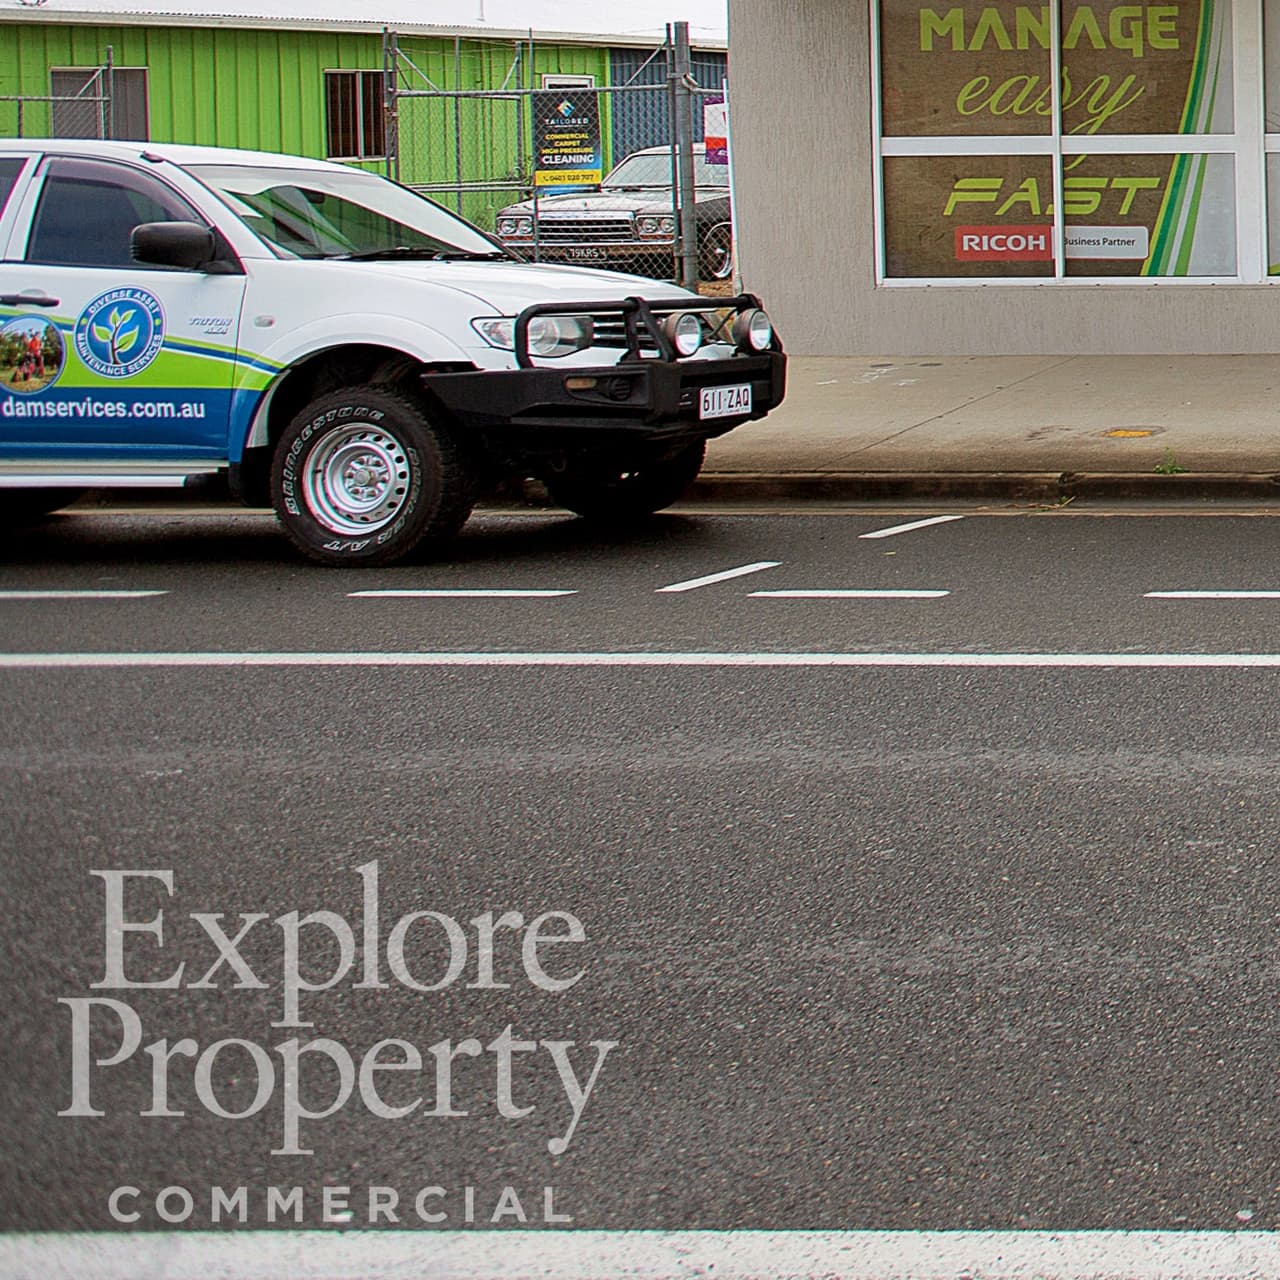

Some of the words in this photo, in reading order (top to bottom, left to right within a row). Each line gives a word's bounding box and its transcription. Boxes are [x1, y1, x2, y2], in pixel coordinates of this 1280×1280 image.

[918, 6, 1180, 58] MANAGE
[956, 65, 1145, 170] easy
[541, 154, 595, 164] CLEANING
[942, 177, 1161, 216] FAST
[962, 234, 1046, 252] RICOH
[1102, 236, 1136, 247] Partner
[88, 288, 132, 314] DIVERSE
[133, 289, 161, 314] ASSET
[76, 332, 127, 376] MAINTENANCE
[127, 333, 162, 374] SERVICES
[2, 396, 205, 418] damservices.com.au
[283, 406, 385, 516] BRIDGESTONE
